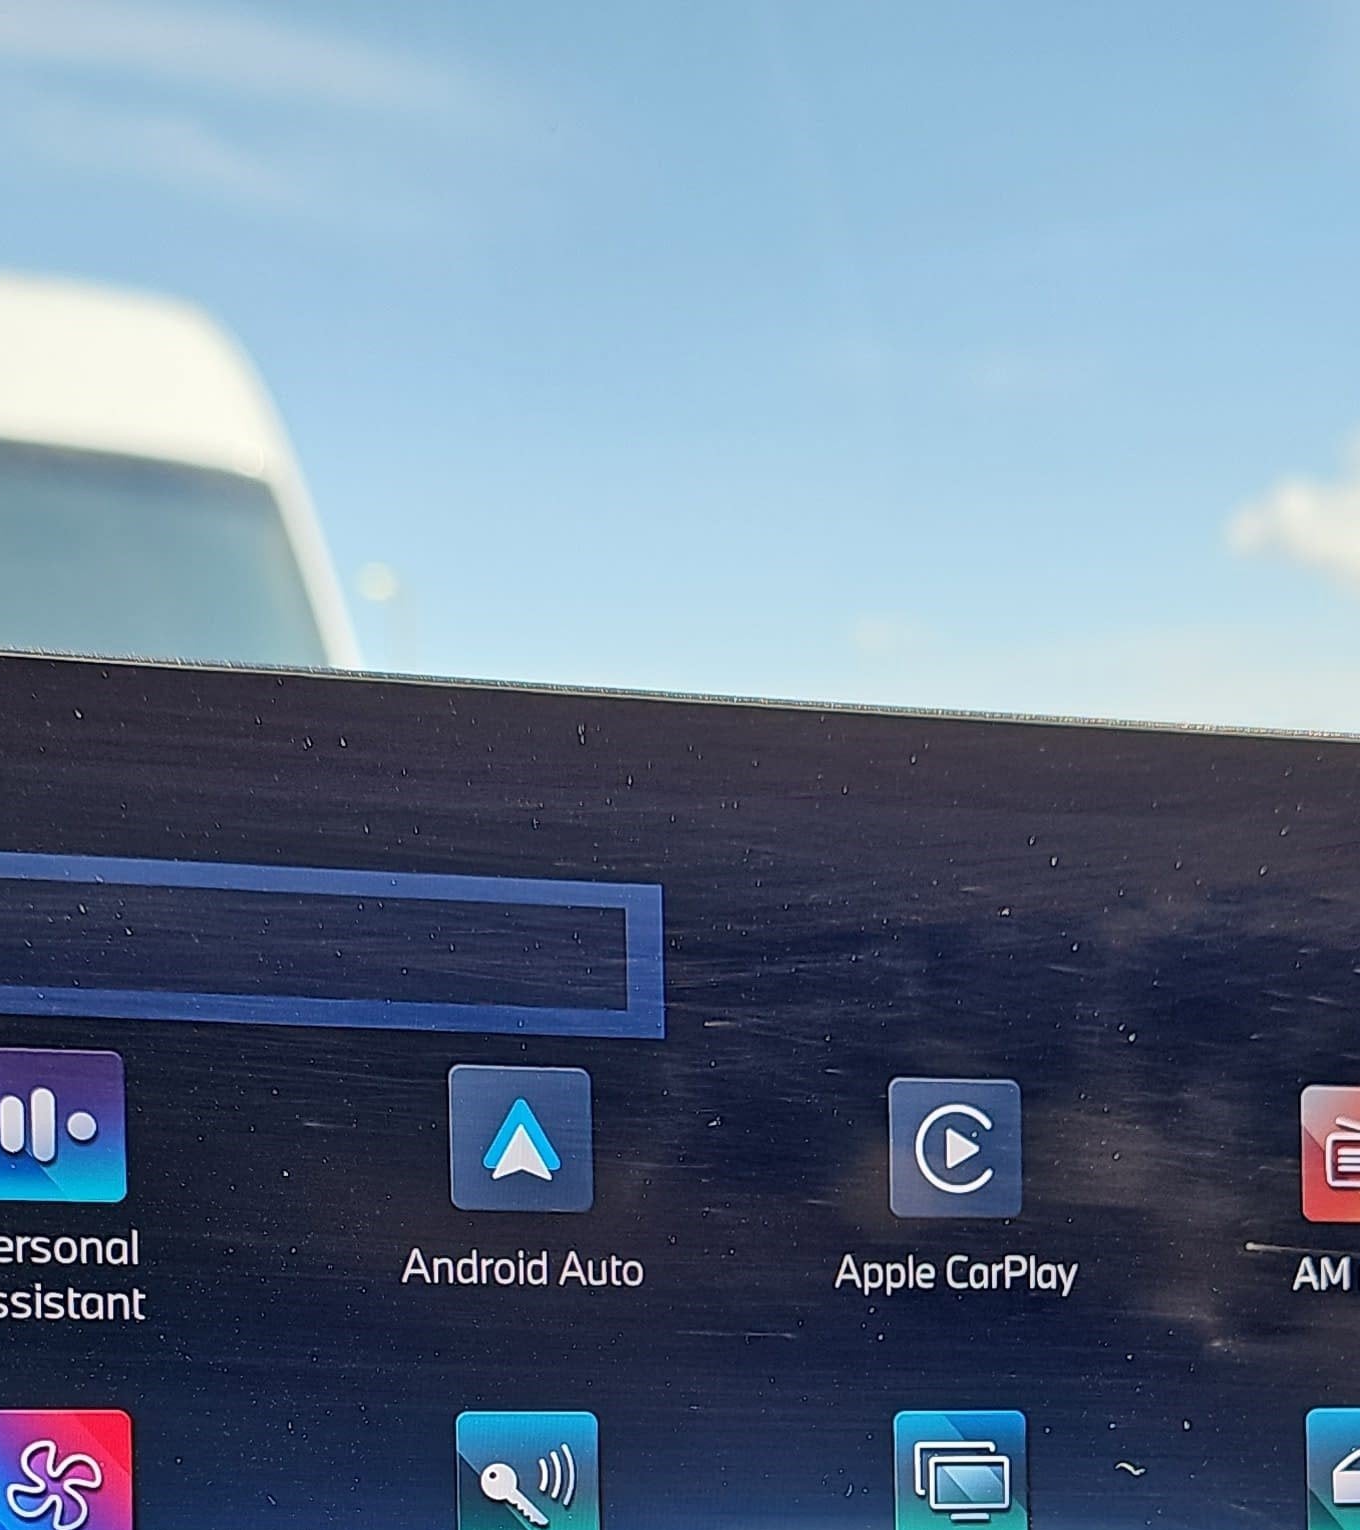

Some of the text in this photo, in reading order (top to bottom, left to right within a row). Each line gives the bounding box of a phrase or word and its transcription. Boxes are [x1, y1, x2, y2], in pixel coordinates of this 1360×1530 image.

[400, 1247, 645, 1287] Android Auto
[834, 1254, 1079, 1297] Apple CarPlay
[1292, 1255, 1352, 1292] AM
